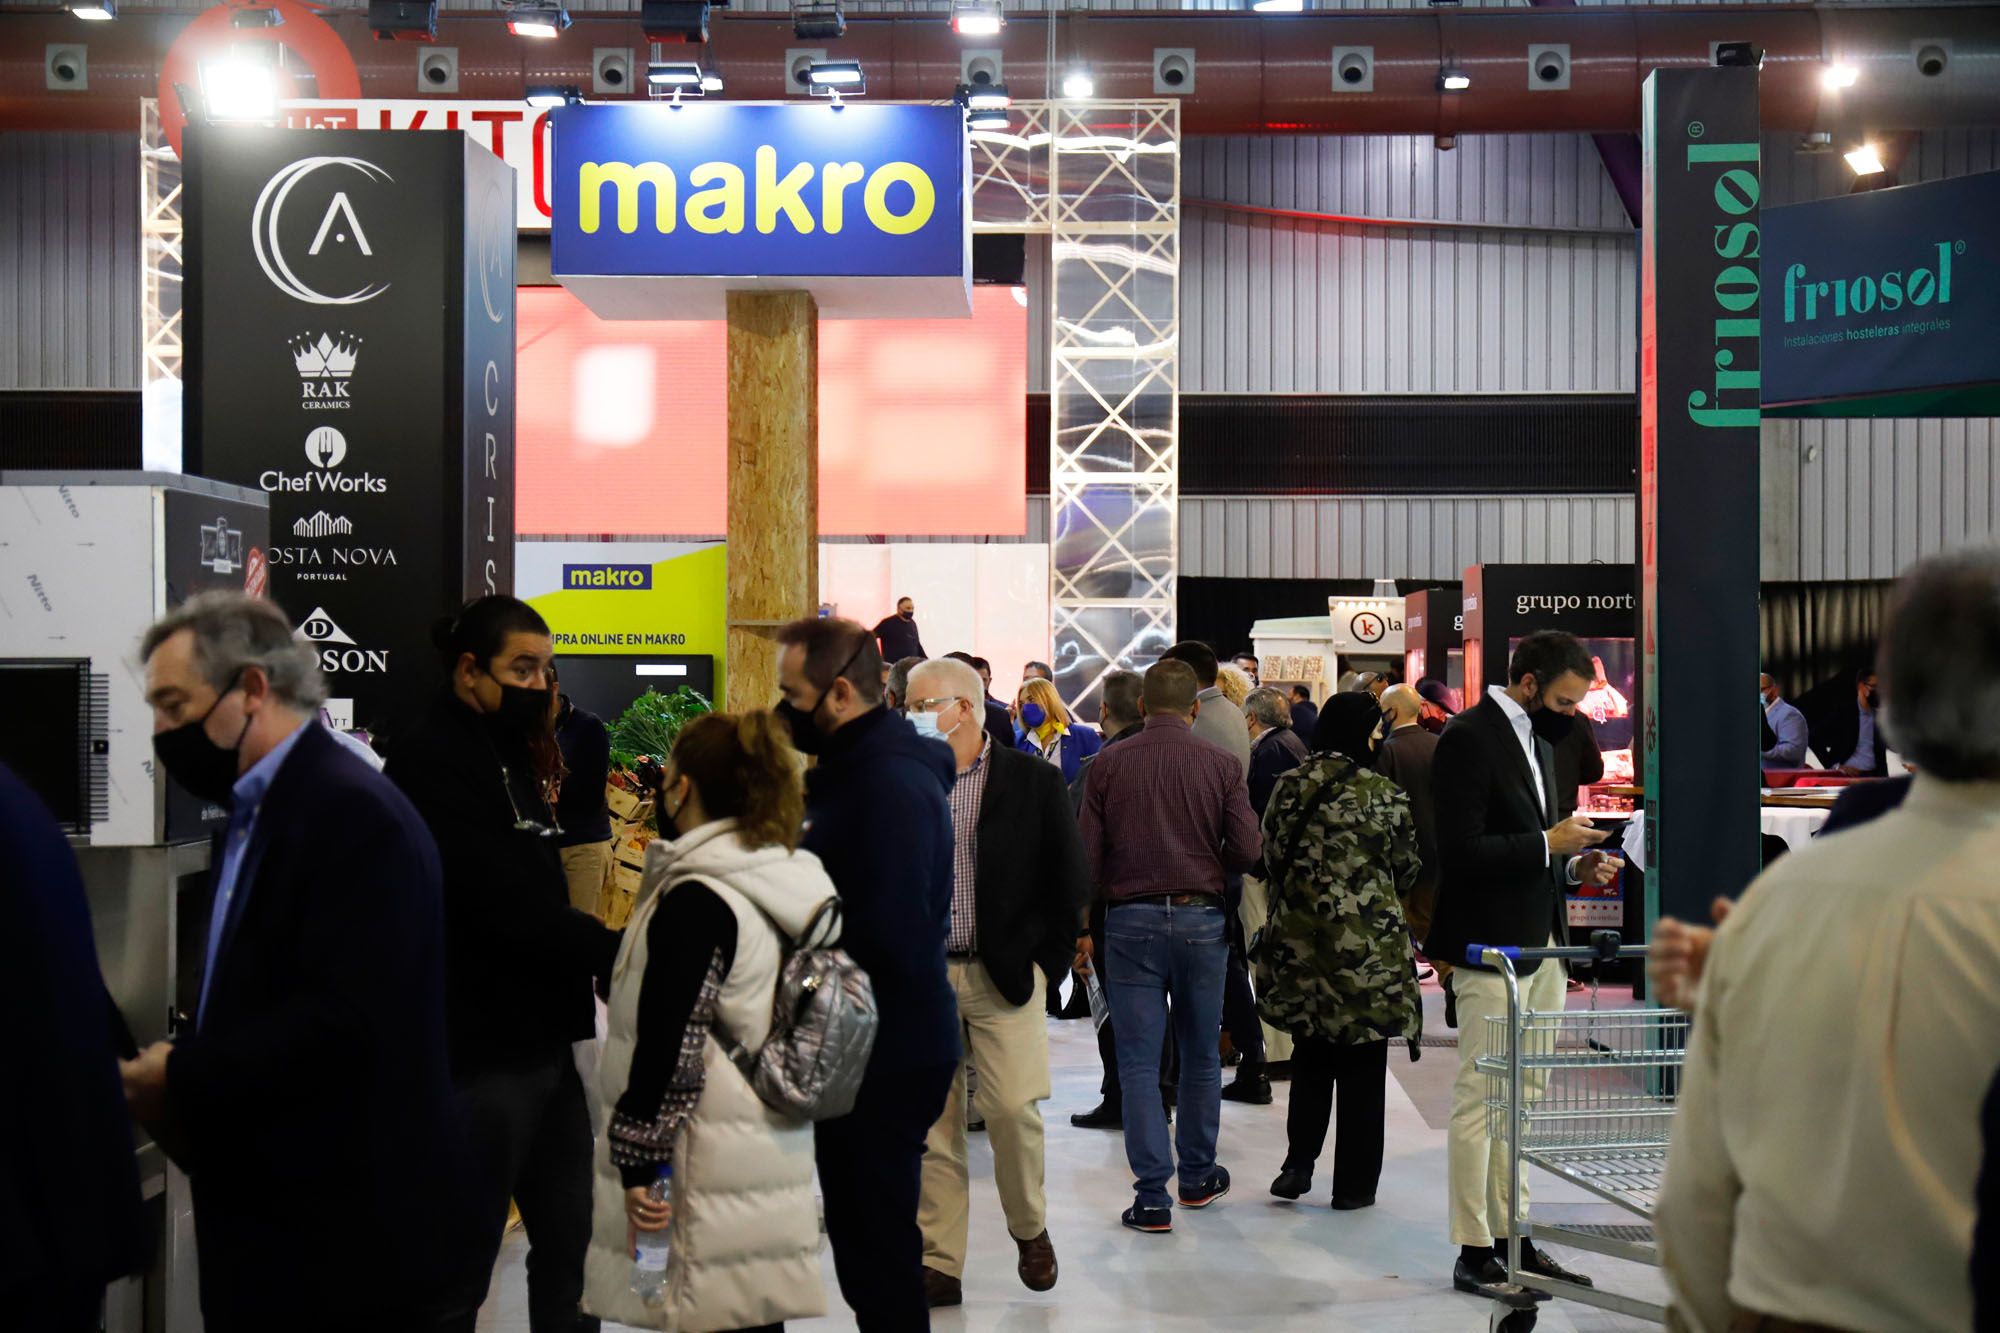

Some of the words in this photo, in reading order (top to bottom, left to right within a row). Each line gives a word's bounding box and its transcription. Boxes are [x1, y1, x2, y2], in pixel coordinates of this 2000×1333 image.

[579, 144, 936, 235] makro
[1784, 331, 1844, 348] Instalaciones
[1846, 324, 1900, 341] hosteleras
[1902, 316, 1952, 335] integrales
[302, 381, 350, 398] RAK
[302, 401, 351, 410] CERAMICS
[259, 470, 313, 492] Chef
[315, 470, 387, 493] Works
[332, 548, 397, 566] NOVA
[296, 572, 348, 581] PORTUGAL
[570, 567, 644, 586] makro
[27, 573, 53, 612] Nitto
[1516, 594, 1580, 615] grupo
[1587, 593, 1636, 609] nort
[310, 621, 328, 636] D
[1388, 617, 1403, 632] la
[552, 634, 578, 645] PRA
[581, 634, 624, 645] ONLINE
[626, 634, 642, 645] EN
[645, 634, 686, 645] MAKRO
[314, 650, 389, 673] SON
